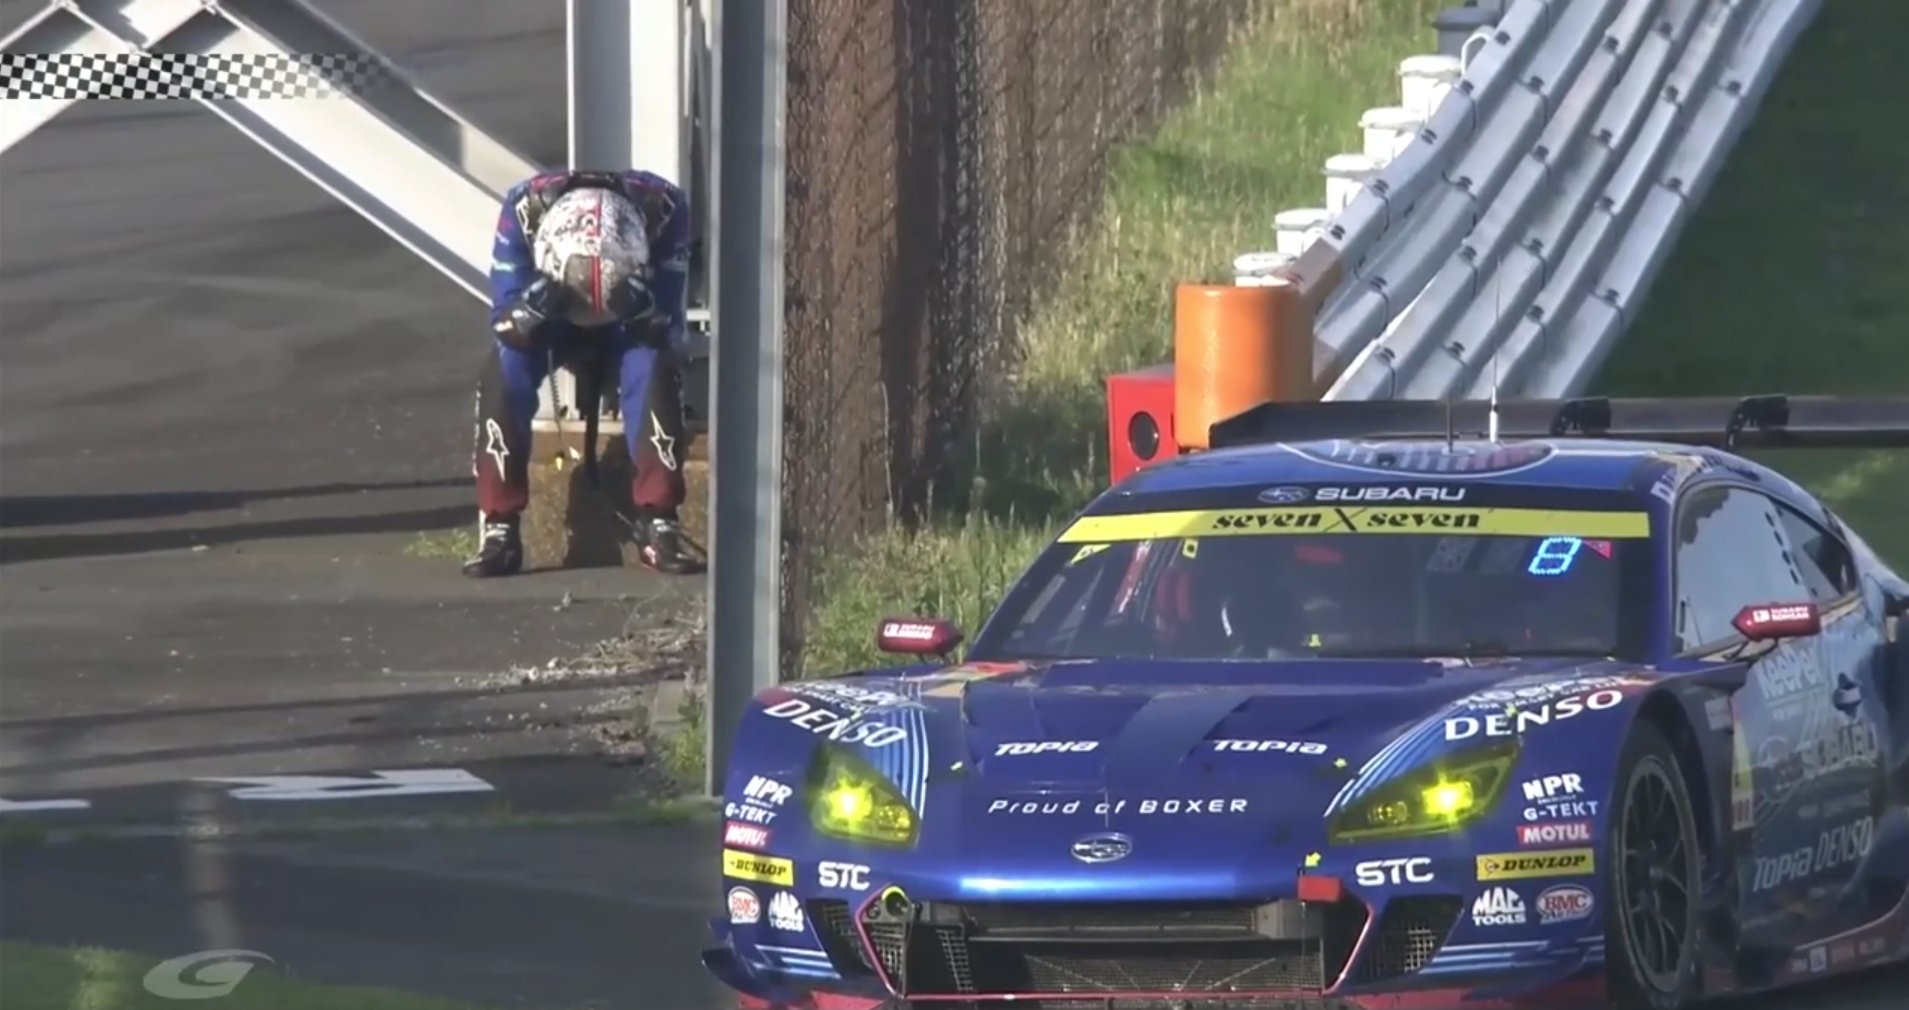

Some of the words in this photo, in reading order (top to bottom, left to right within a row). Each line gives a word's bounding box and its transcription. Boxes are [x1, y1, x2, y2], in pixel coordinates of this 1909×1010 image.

[1315, 487, 1466, 501] SUBARU
[1212, 513, 1322, 529] seven
[1366, 512, 1480, 528] seven
[1528, 536, 1582, 575] 8
[762, 698, 908, 748] DENSO
[1444, 690, 1623, 740] DENSO
[743, 775, 793, 805] NPR
[1522, 773, 1584, 800] NPR
[725, 802, 777, 824] G-TEKT
[988, 799, 1081, 814] Proud
[1094, 800, 1126, 814] of
[1139, 799, 1248, 814] BOXER
[1523, 800, 1598, 821] G-TEKT
[1523, 823, 1590, 843] MOTUL
[1814, 815, 1875, 873] DENSO
[736, 858, 787, 876] DUNLOP
[1355, 857, 1434, 886] STC
[1502, 855, 1587, 871] DUNLOP
[818, 861, 871, 891] STC
[1472, 887, 1526, 916] MAC
[1472, 912, 1527, 927] TOOLS
